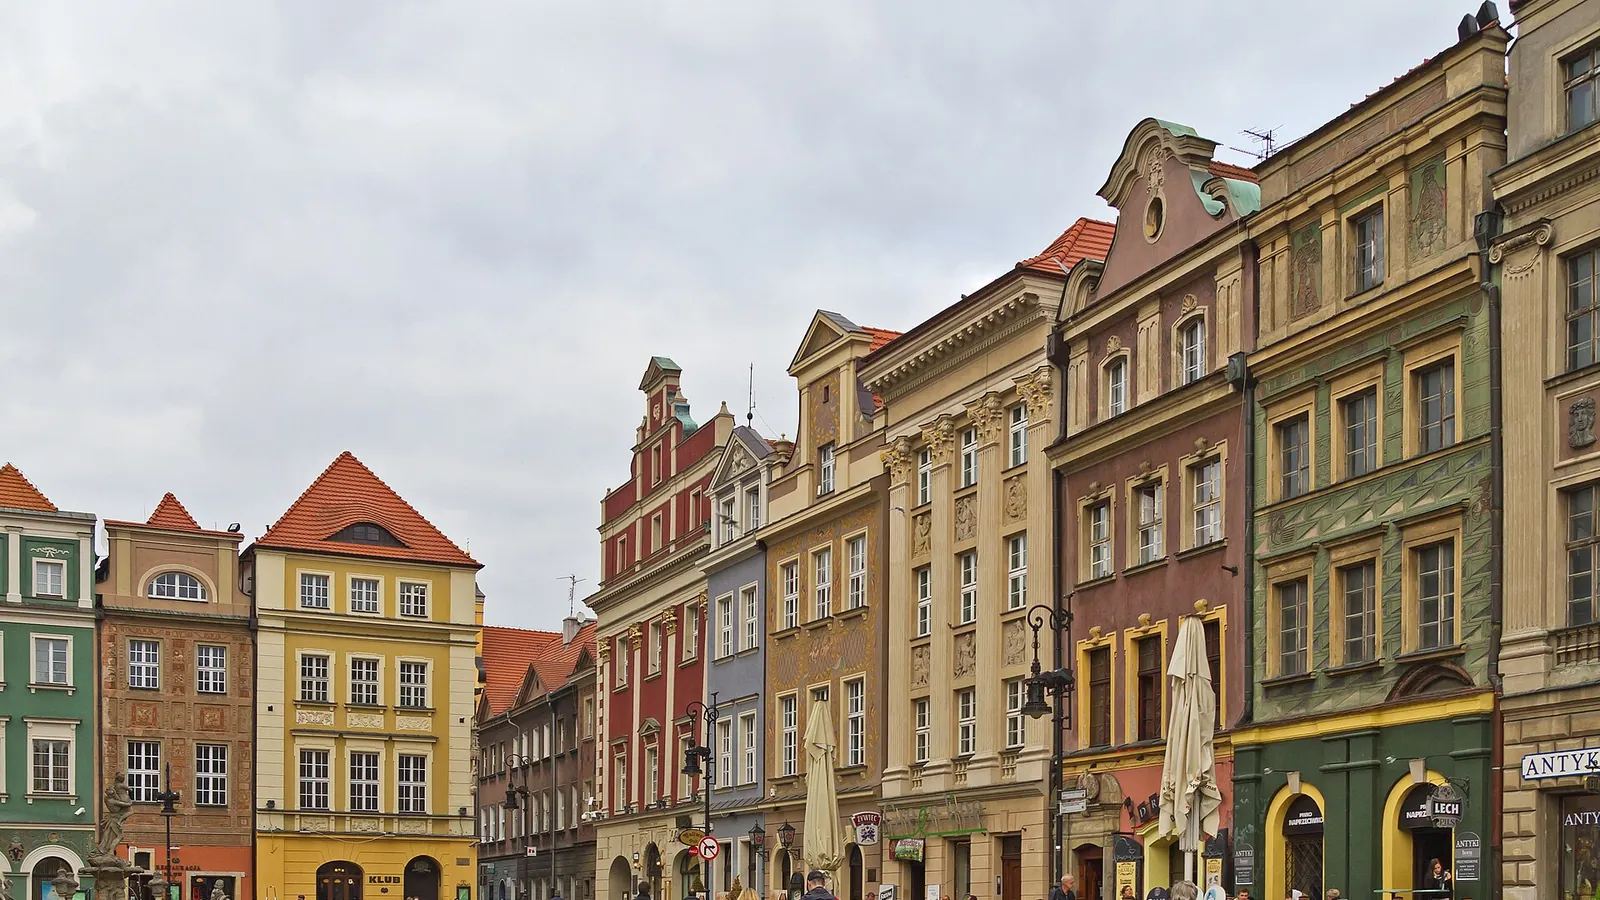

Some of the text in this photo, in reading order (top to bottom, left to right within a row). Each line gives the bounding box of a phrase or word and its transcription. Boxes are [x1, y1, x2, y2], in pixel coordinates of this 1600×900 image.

[1434, 802, 1459, 814] LECH
[1406, 811, 1427, 819] NAPRZ
[1456, 840, 1479, 848] ANTYKI
[368, 876, 401, 884] KLUB
